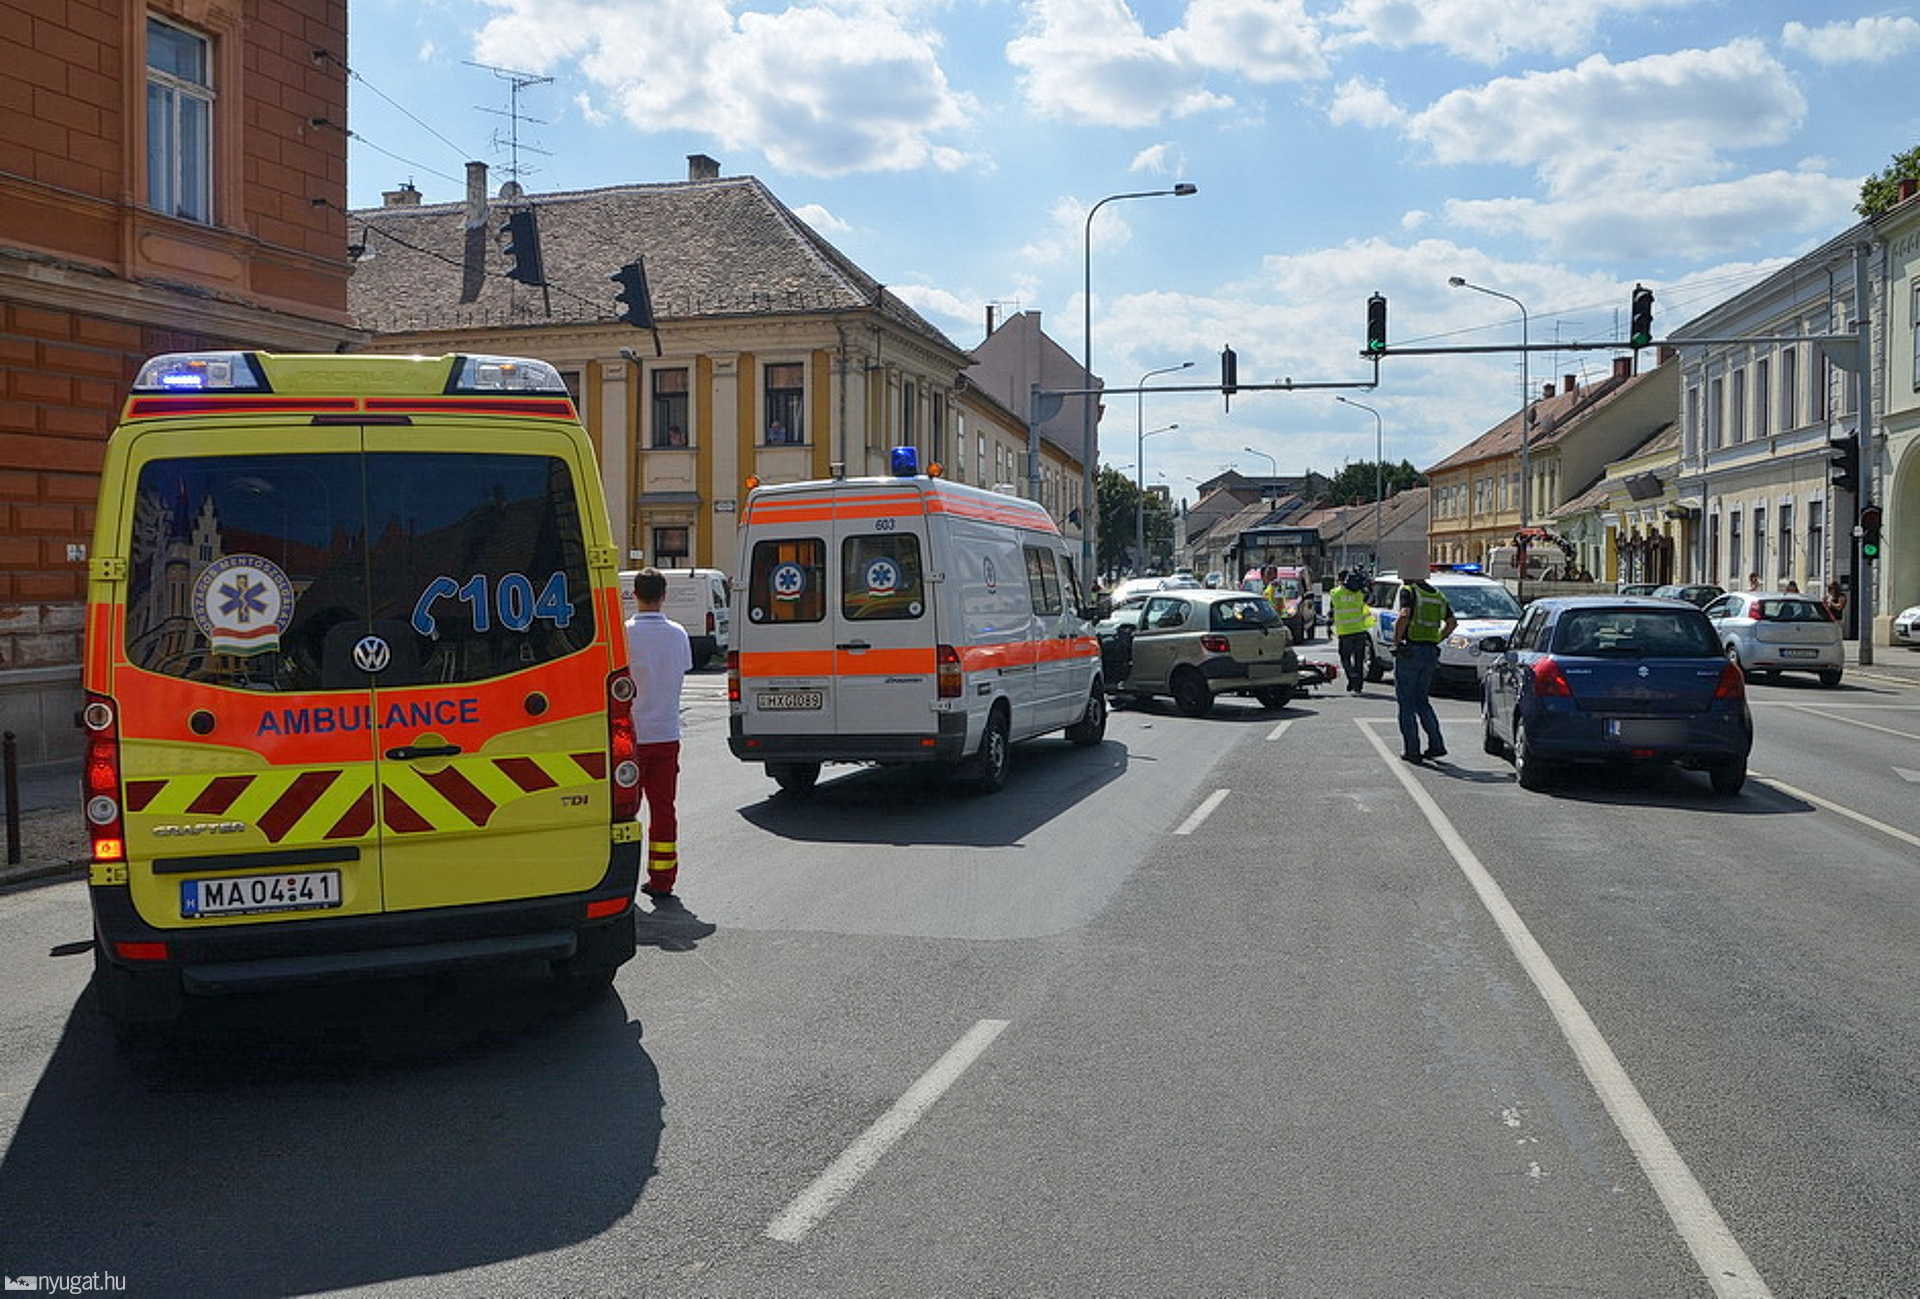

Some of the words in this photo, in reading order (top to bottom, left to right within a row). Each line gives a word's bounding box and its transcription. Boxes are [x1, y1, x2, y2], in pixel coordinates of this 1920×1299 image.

[875, 518, 897, 531] 603
[459, 571, 575, 631] 104
[256, 698, 480, 736] AMBULANCE
[153, 822, 246, 837] CRAFTER
